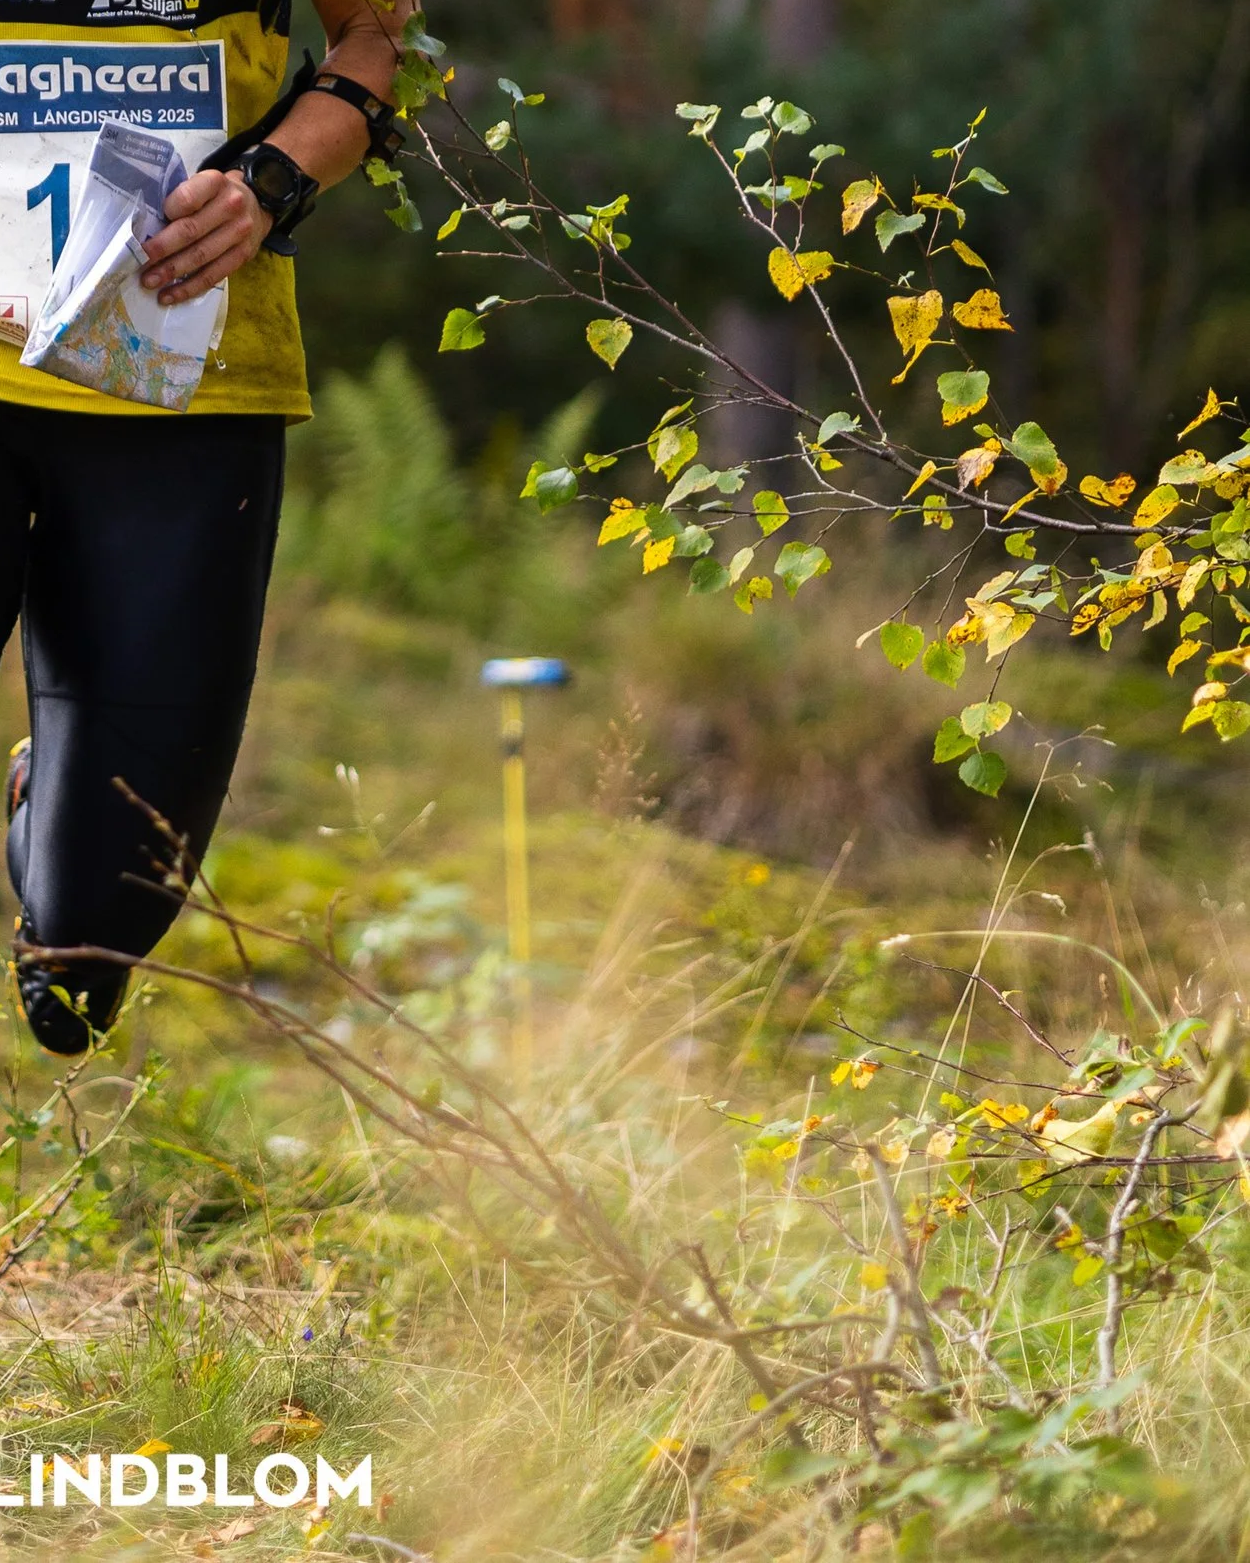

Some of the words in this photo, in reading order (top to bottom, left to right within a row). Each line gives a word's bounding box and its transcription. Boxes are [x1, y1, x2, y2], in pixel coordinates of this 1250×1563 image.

[33, 109, 153, 126] LÅNGDISTANS
[157, 108, 195, 123] 2025
[26, 162, 70, 272] 1
